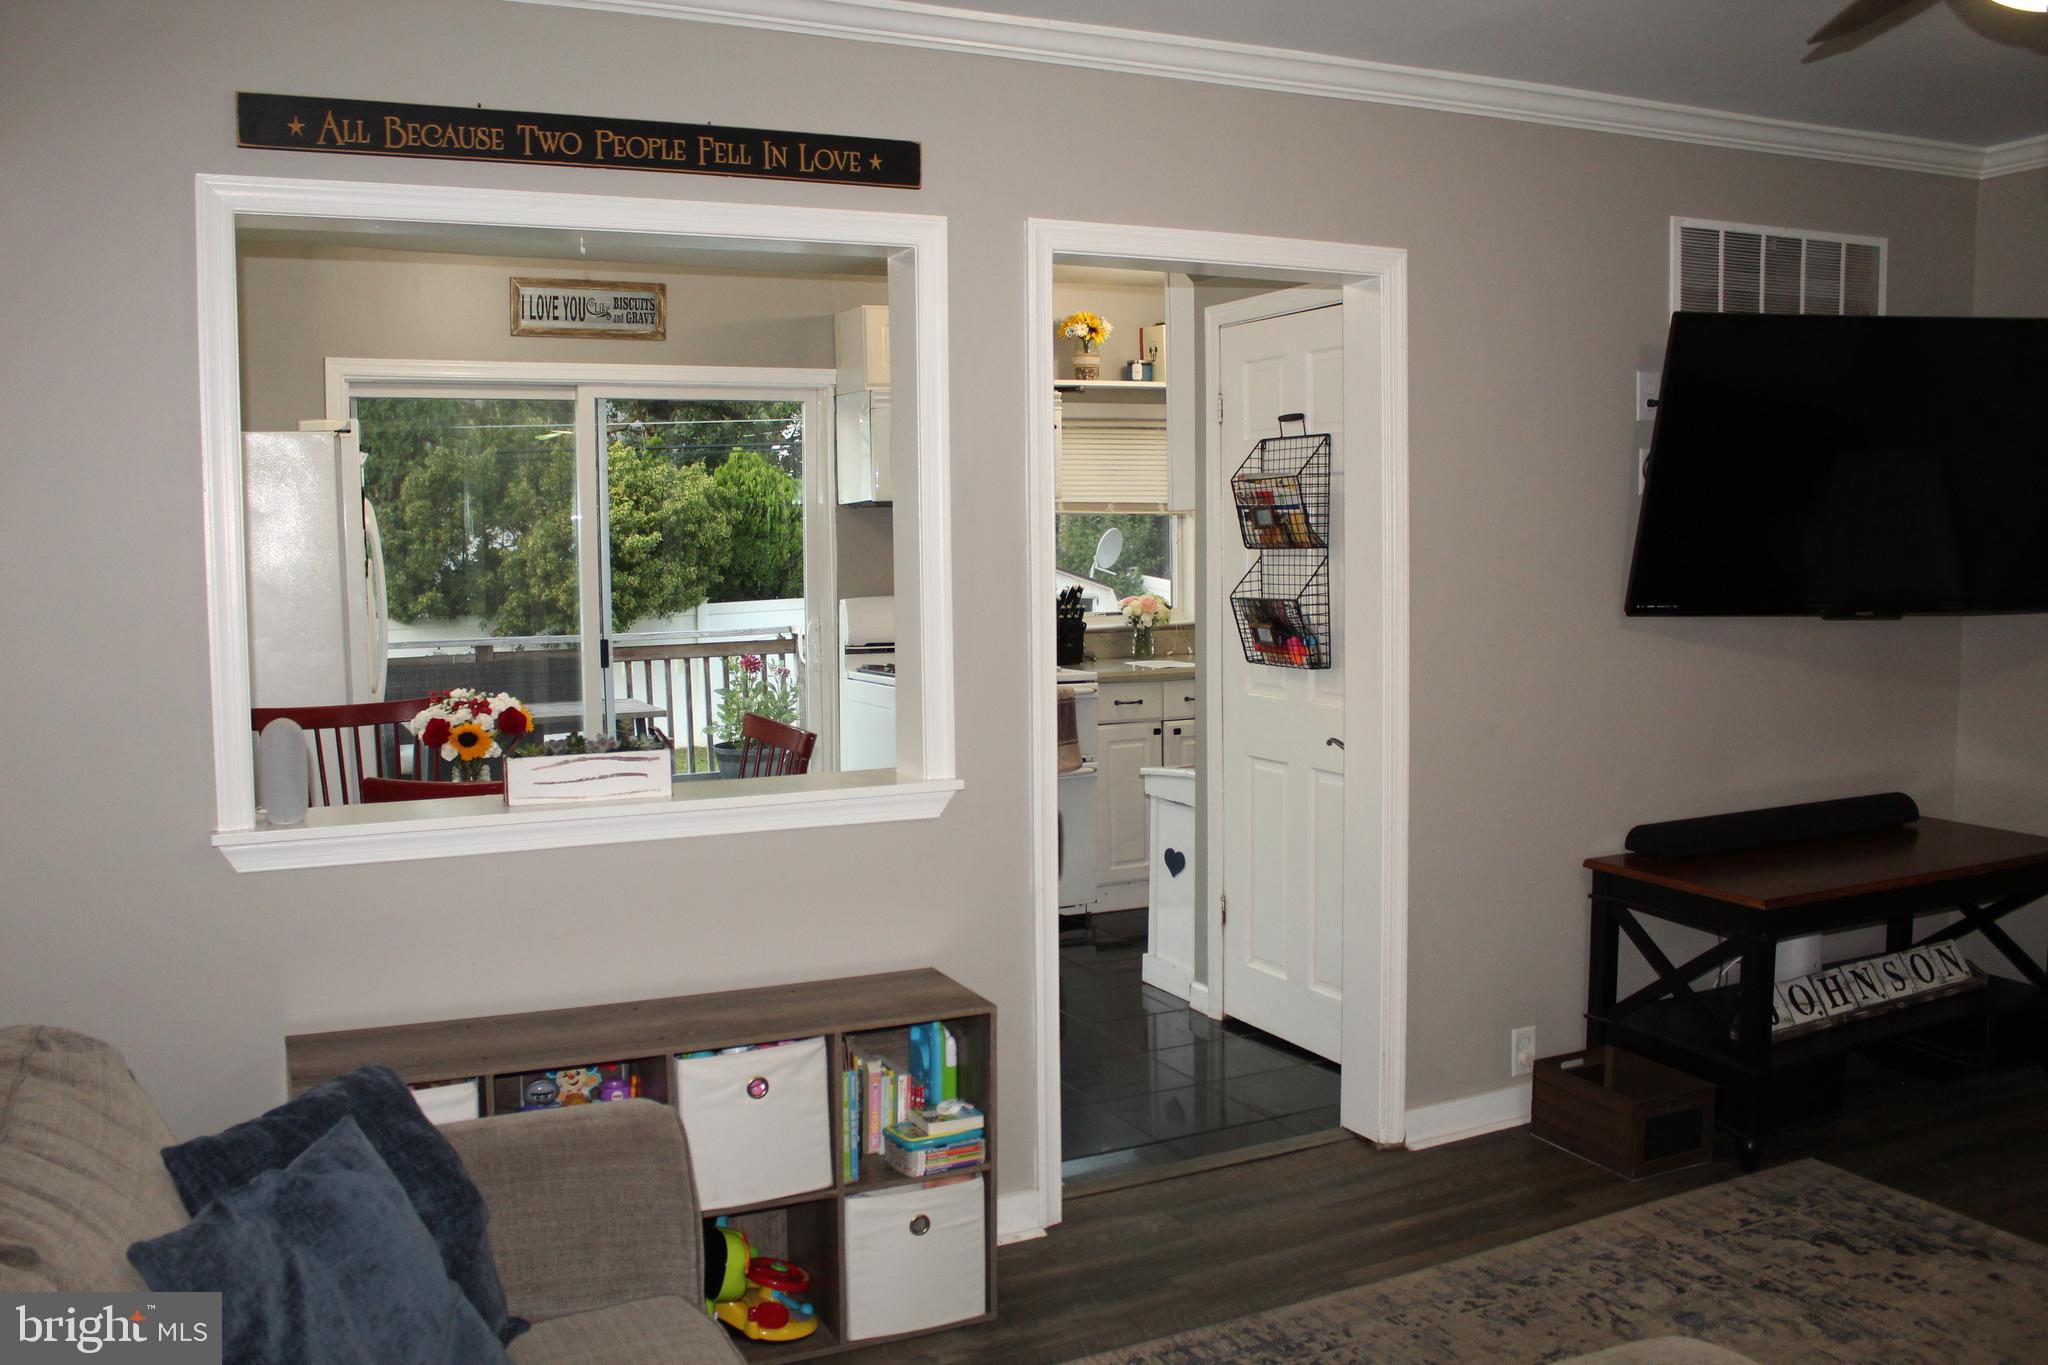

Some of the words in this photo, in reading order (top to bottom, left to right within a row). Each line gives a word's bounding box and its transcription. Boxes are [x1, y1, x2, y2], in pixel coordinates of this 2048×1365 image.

[521, 294, 525, 319] I
[529, 294, 560, 321] LOVE
[563, 296, 586, 322] YOU
[613, 297, 656, 312] BISCUITS
[613, 314, 624, 324] and
[626, 312, 656, 325] GRAVY
[1772, 945, 1969, 1025] OHNSON
